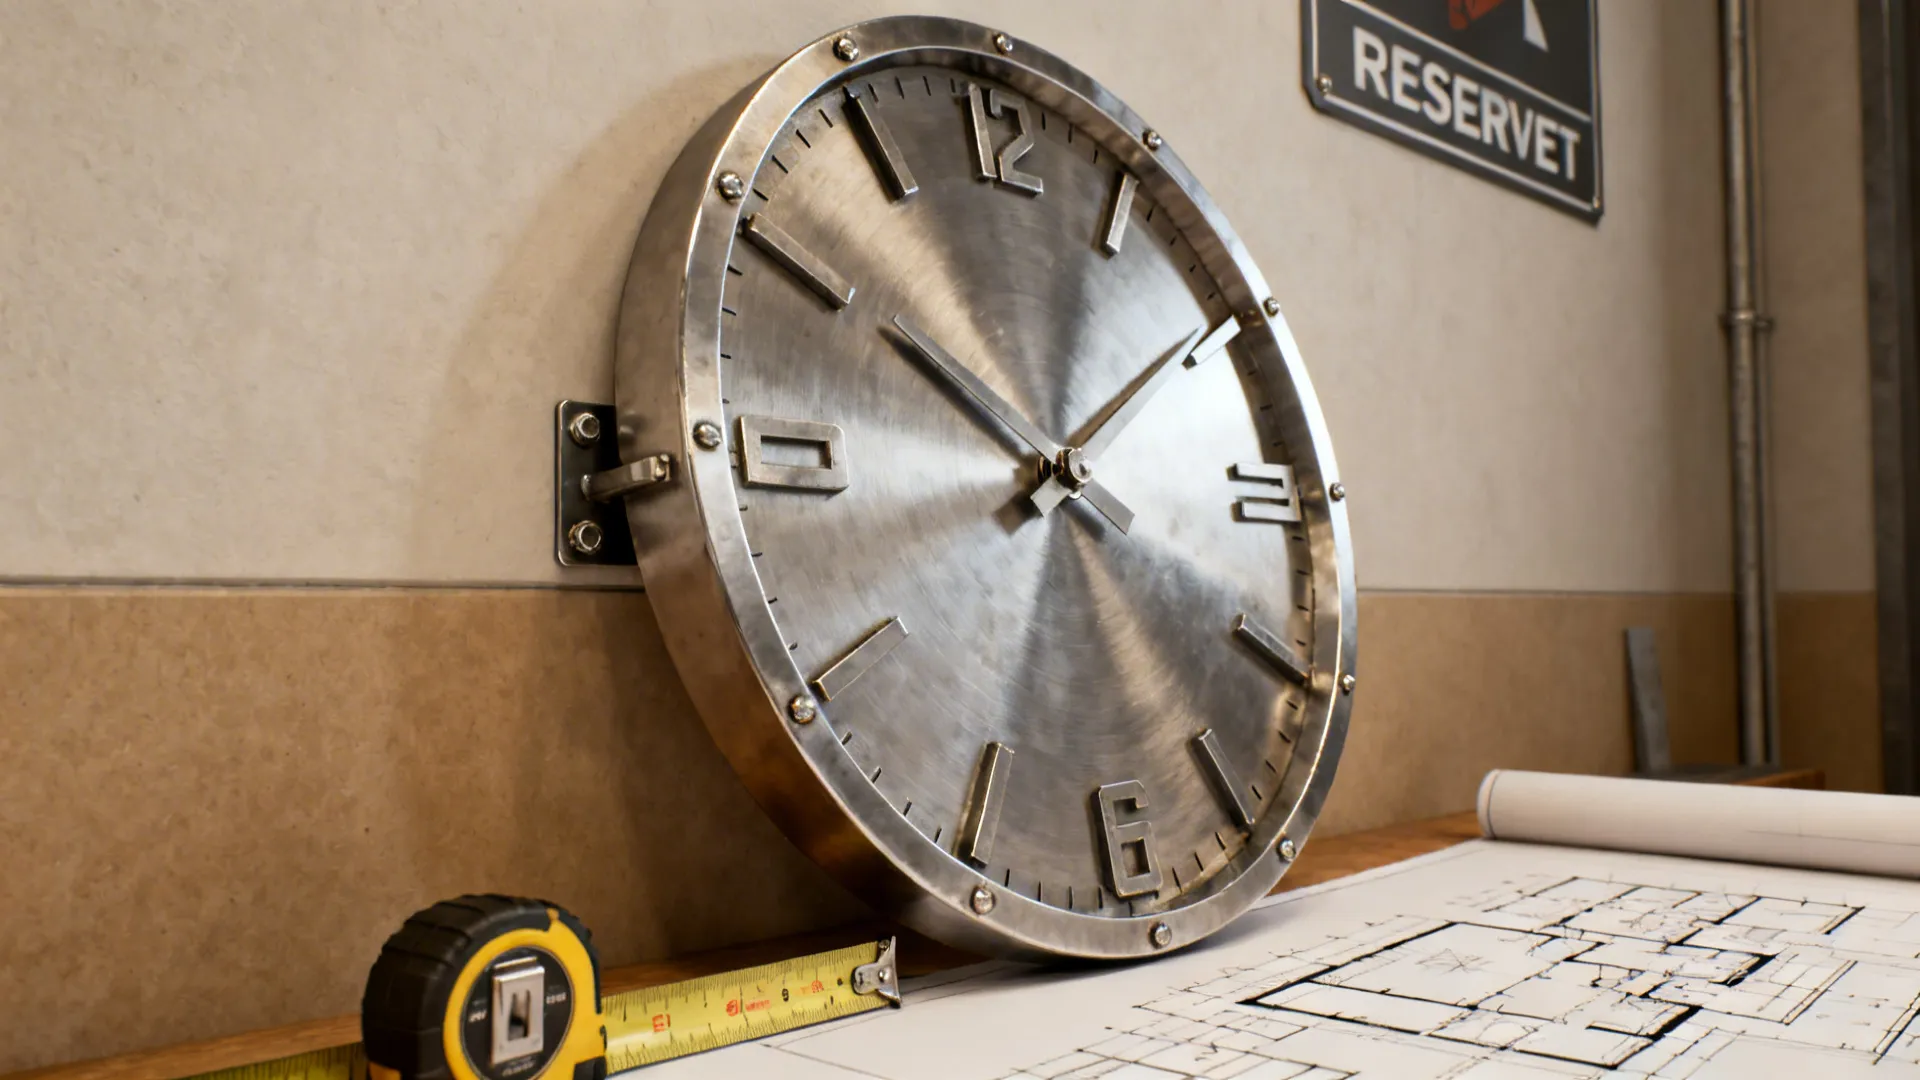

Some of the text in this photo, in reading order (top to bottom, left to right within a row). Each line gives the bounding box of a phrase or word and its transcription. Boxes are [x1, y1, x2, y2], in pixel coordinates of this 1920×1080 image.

[968, 83, 1044, 194] 12
[1353, 25, 1580, 181] RESERVET
[1098, 779, 1163, 898] 6
